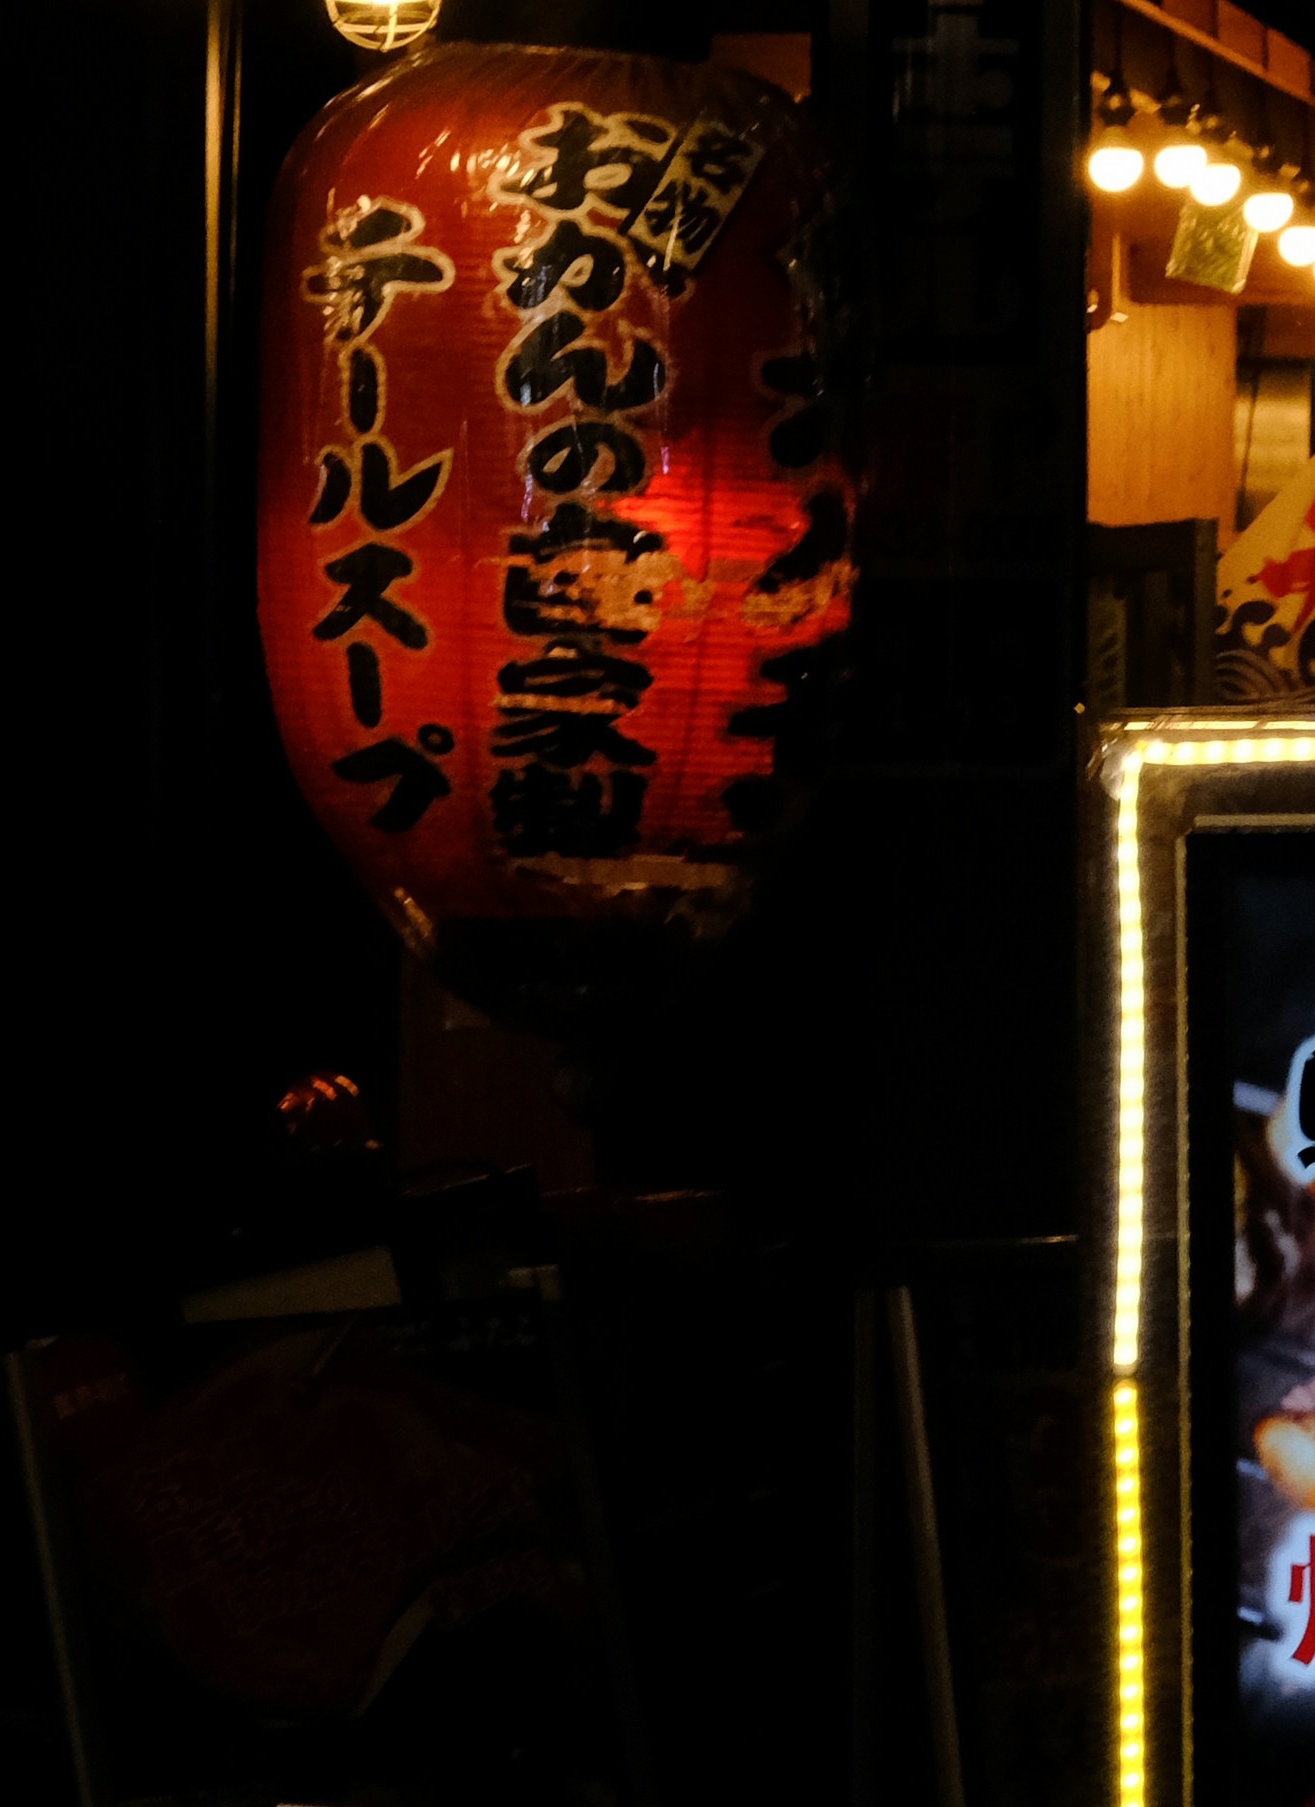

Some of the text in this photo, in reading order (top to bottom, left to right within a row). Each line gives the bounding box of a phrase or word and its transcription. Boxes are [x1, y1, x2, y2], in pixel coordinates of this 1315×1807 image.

[301, 197, 456, 834] テールスープ
